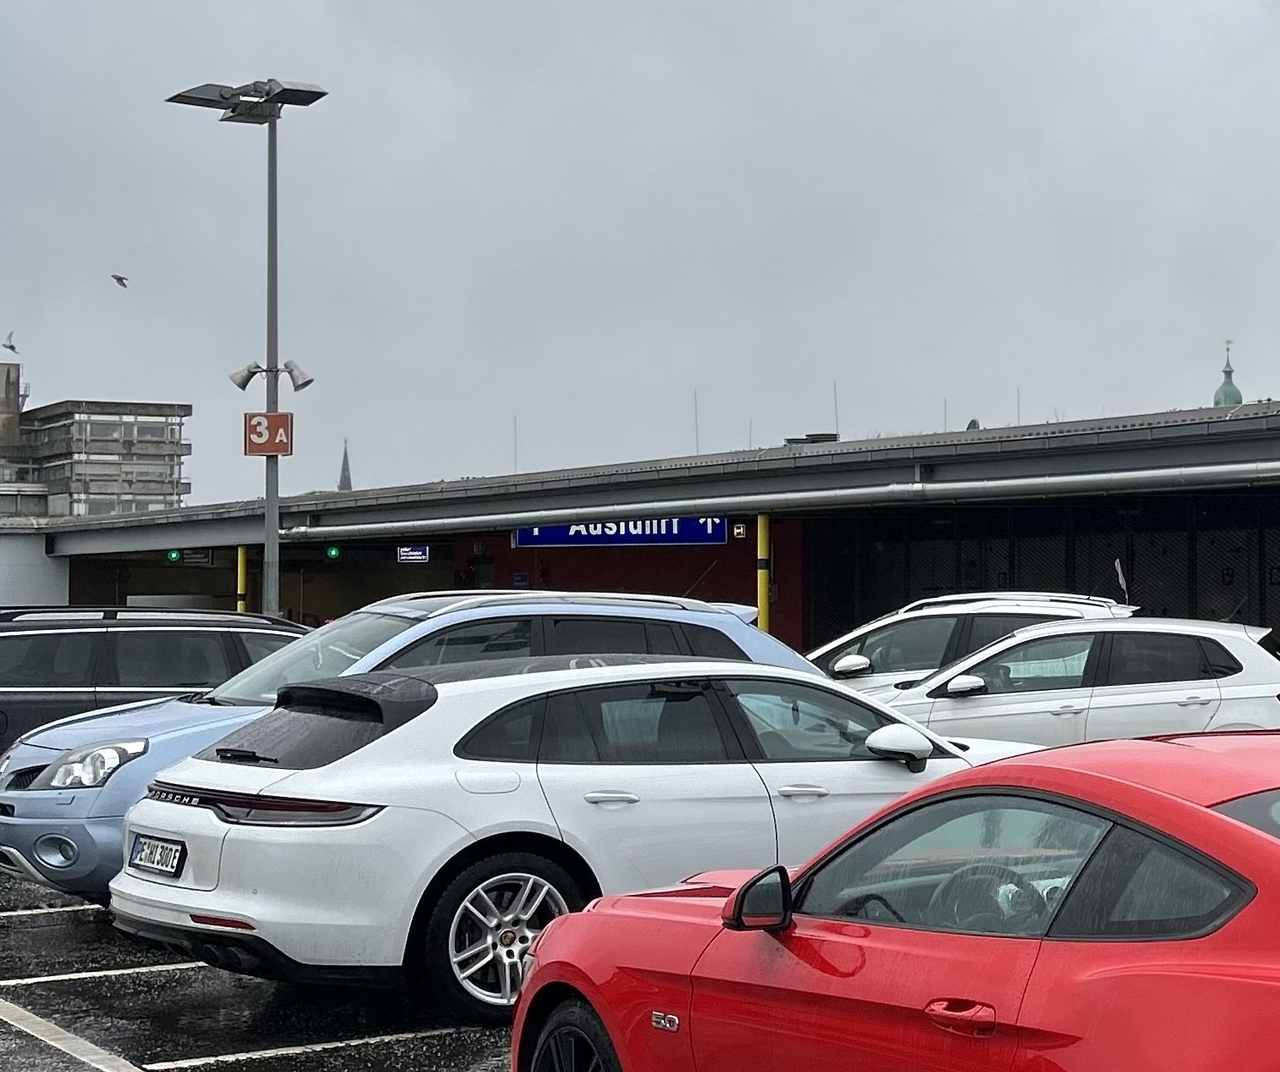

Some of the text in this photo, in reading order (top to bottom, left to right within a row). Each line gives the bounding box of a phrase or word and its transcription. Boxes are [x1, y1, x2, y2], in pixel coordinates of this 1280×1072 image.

[250, 416, 288, 444] 3 A
[652, 1011, 679, 1032] 5.0
